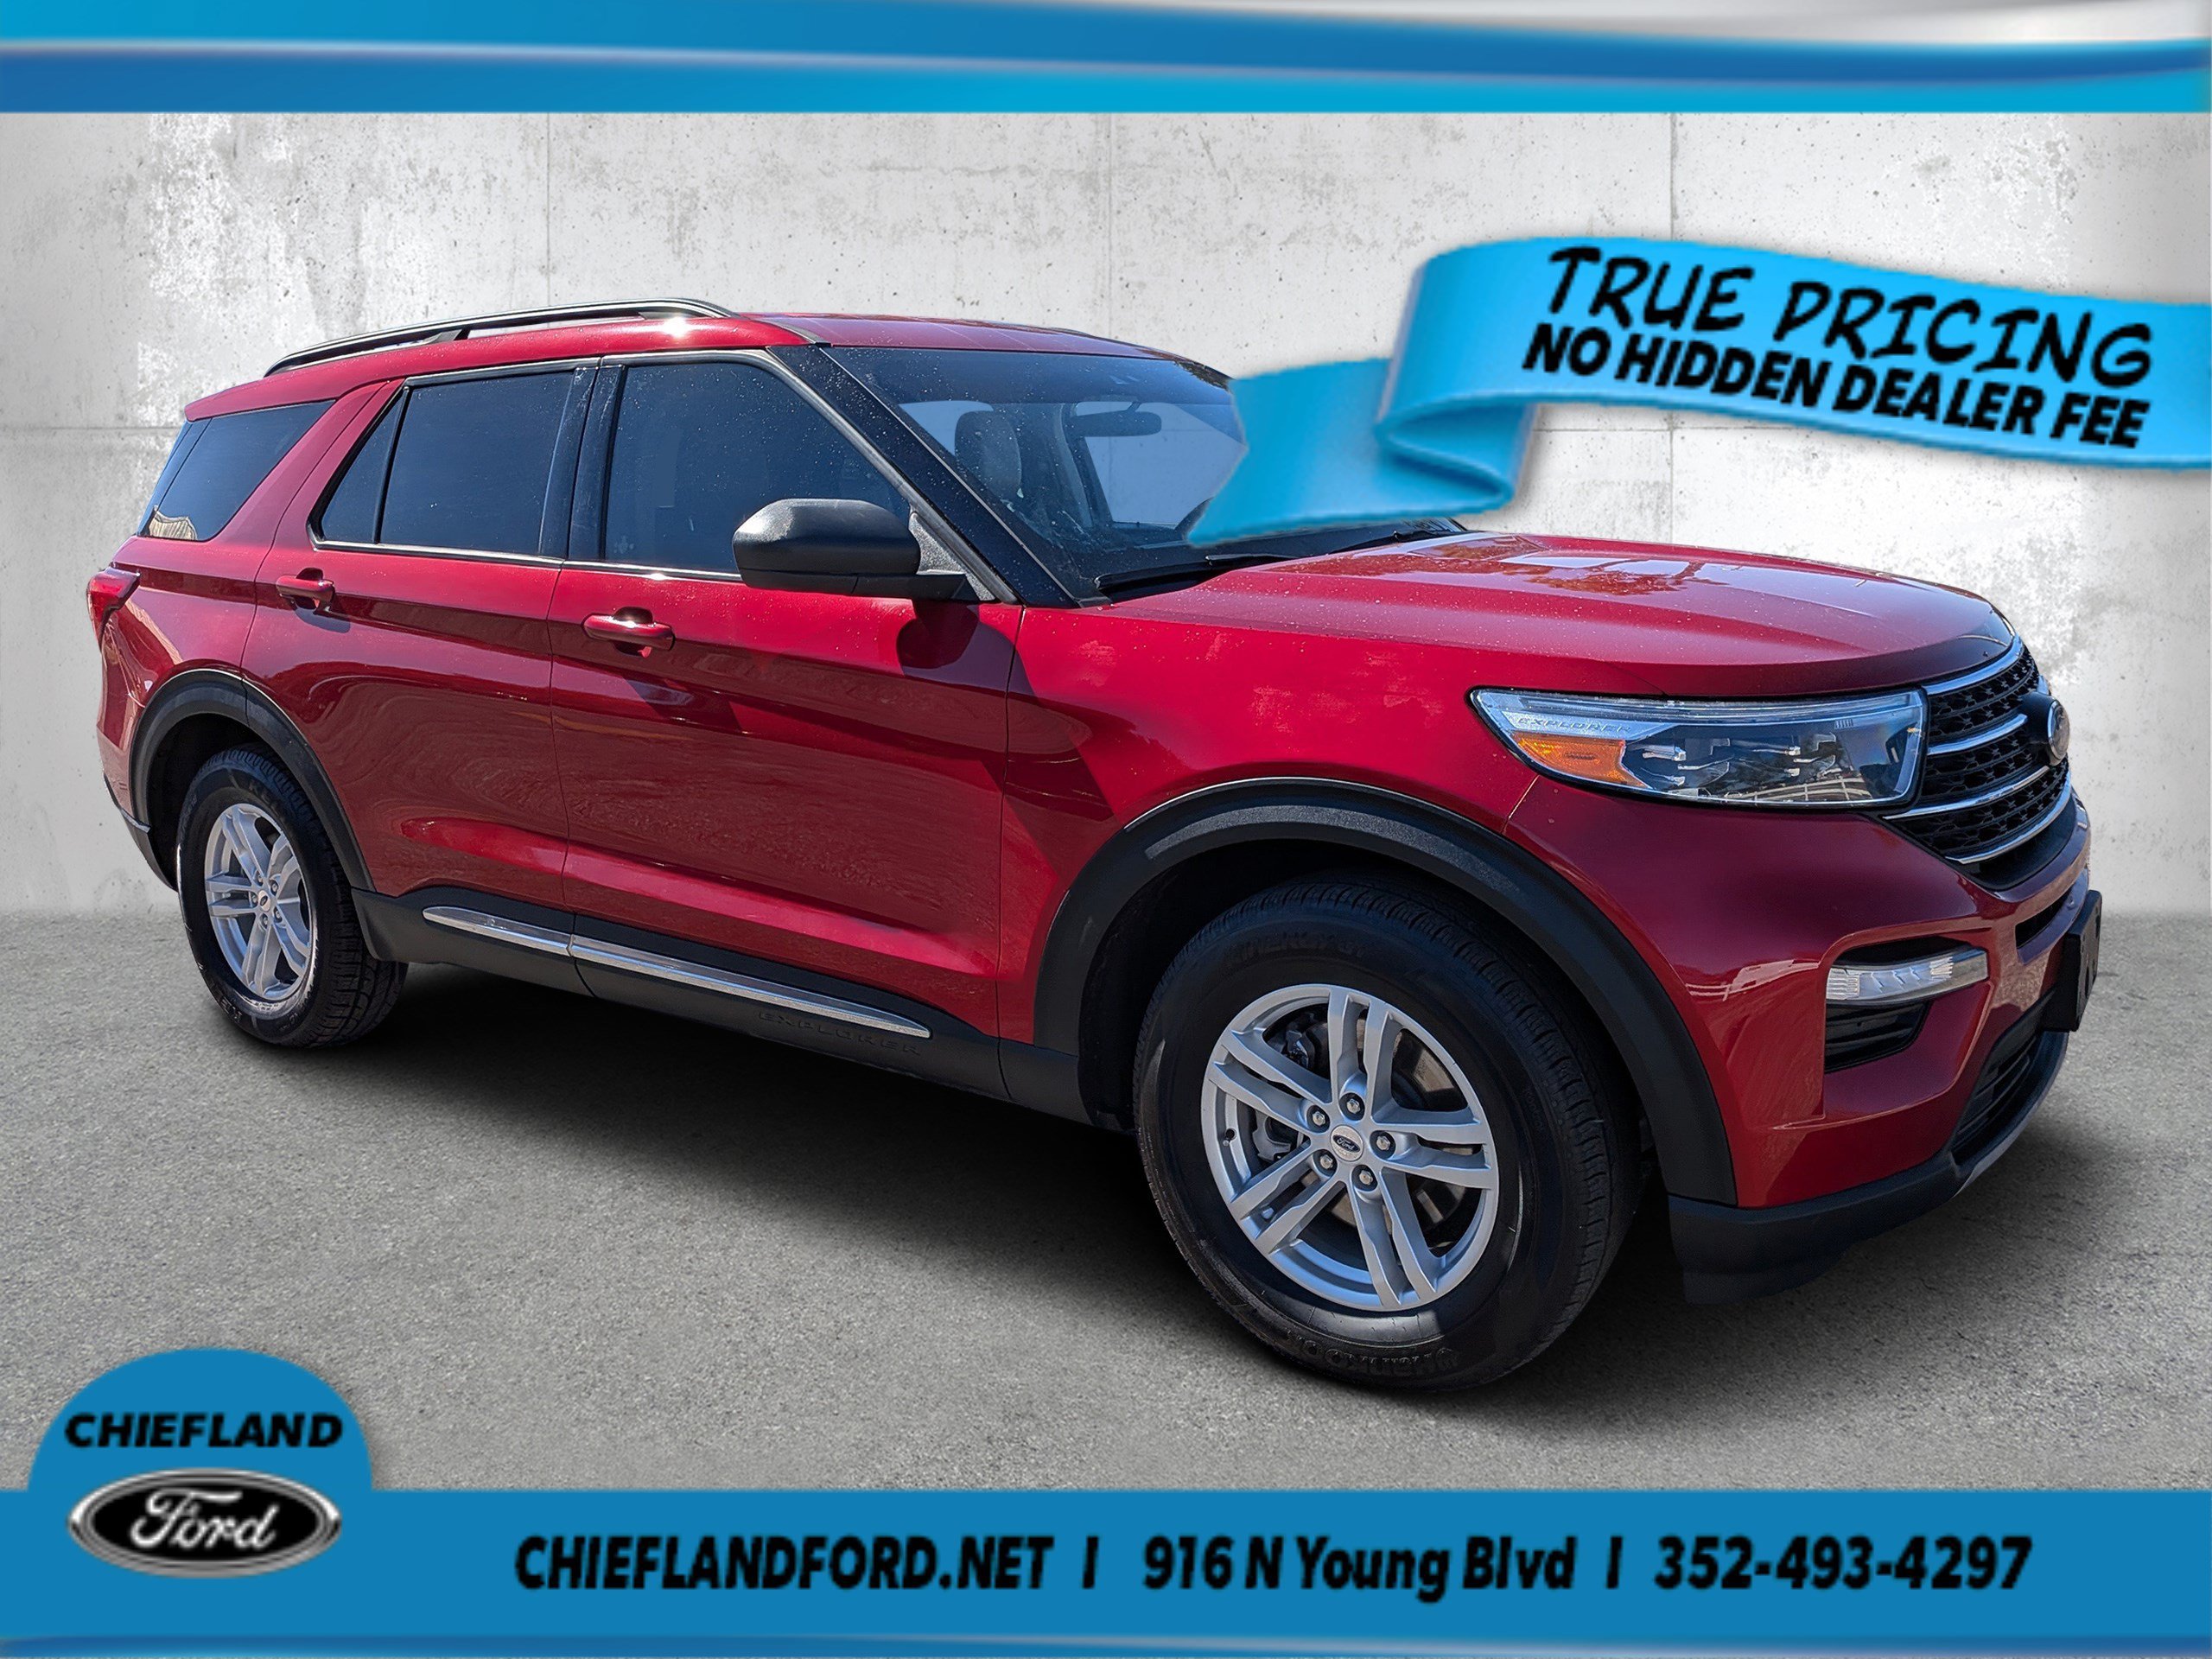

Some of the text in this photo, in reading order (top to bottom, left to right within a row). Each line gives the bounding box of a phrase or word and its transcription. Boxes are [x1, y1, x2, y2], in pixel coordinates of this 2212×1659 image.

[1517, 716, 1631, 734] EXPLORER
[758, 1010, 921, 1057] EXPLORER
[1337, 1136, 1355, 1150] Ford
